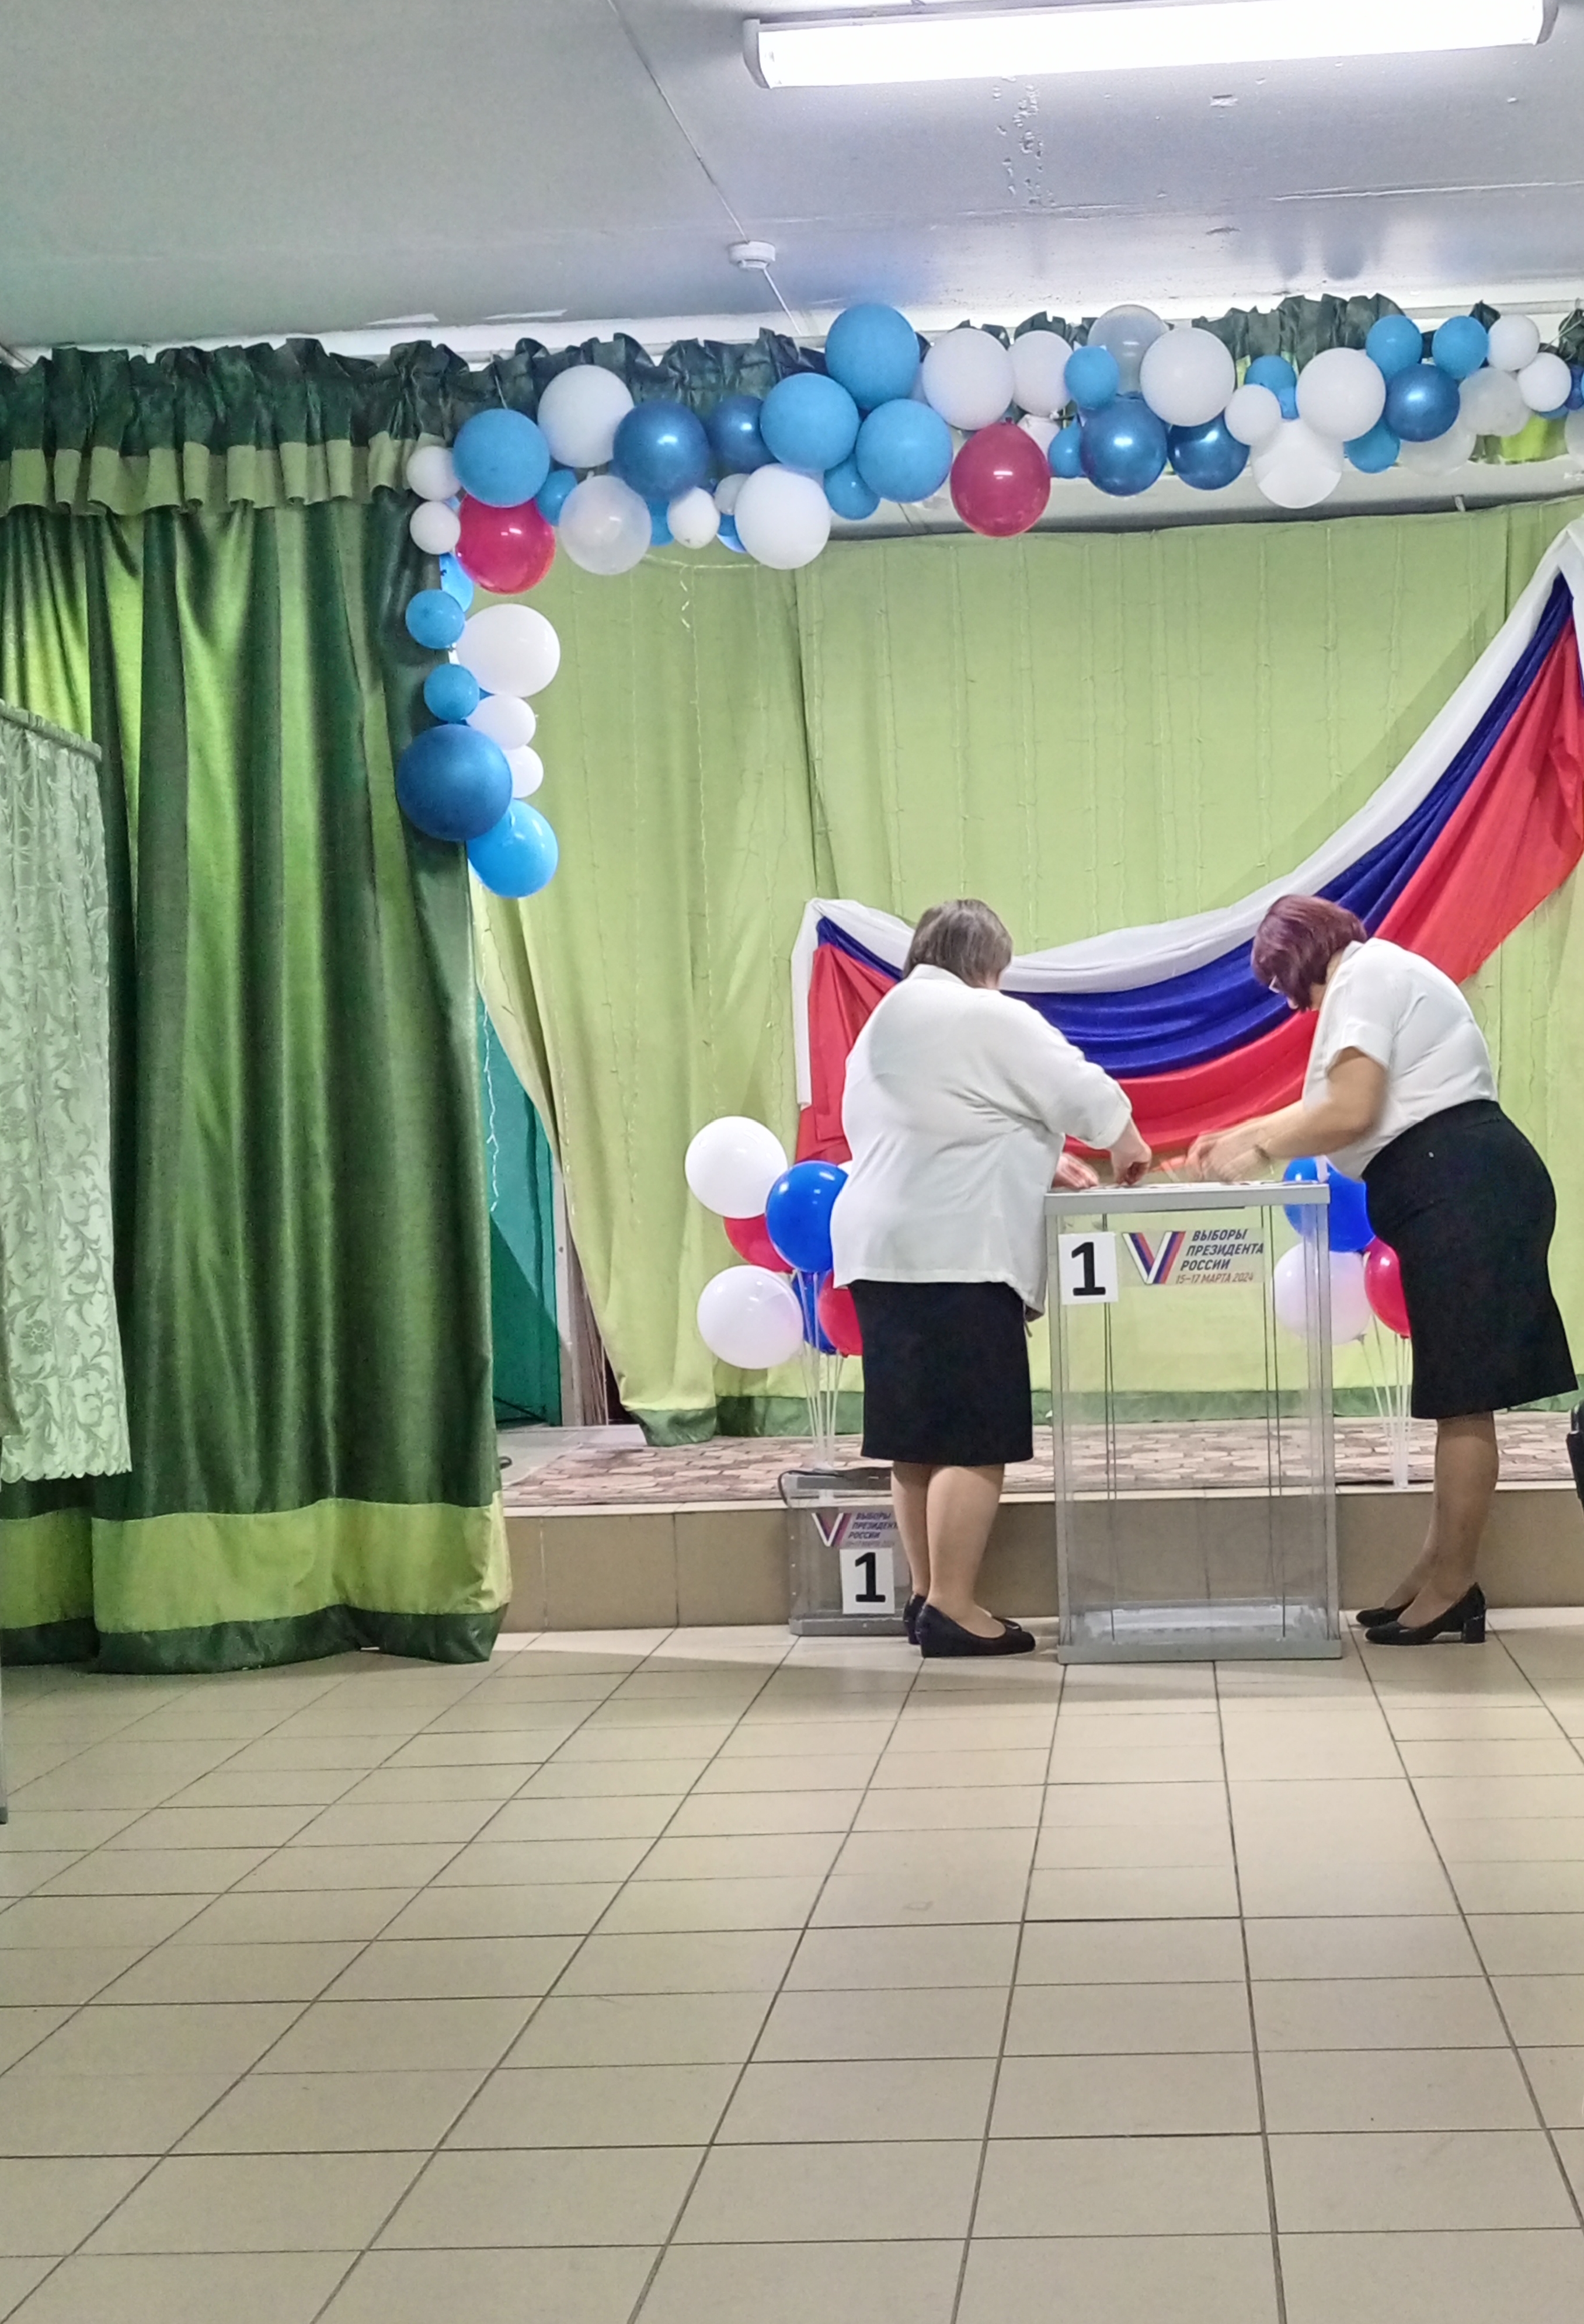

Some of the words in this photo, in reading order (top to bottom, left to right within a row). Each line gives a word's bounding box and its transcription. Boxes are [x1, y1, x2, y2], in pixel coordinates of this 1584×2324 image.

[1192, 1229, 1248, 1241] ВЫБОРЫ
[1186, 1243, 1263, 1257] ПРЕЗИДЕНТА
[1071, 1241, 1106, 1296] 1
[1180, 1259, 1231, 1271] РОССИИ
[1201, 1273, 1231, 1283] МАРТА
[1232, 1272, 1254, 1282] 2024
[855, 1551, 886, 1603] 1
